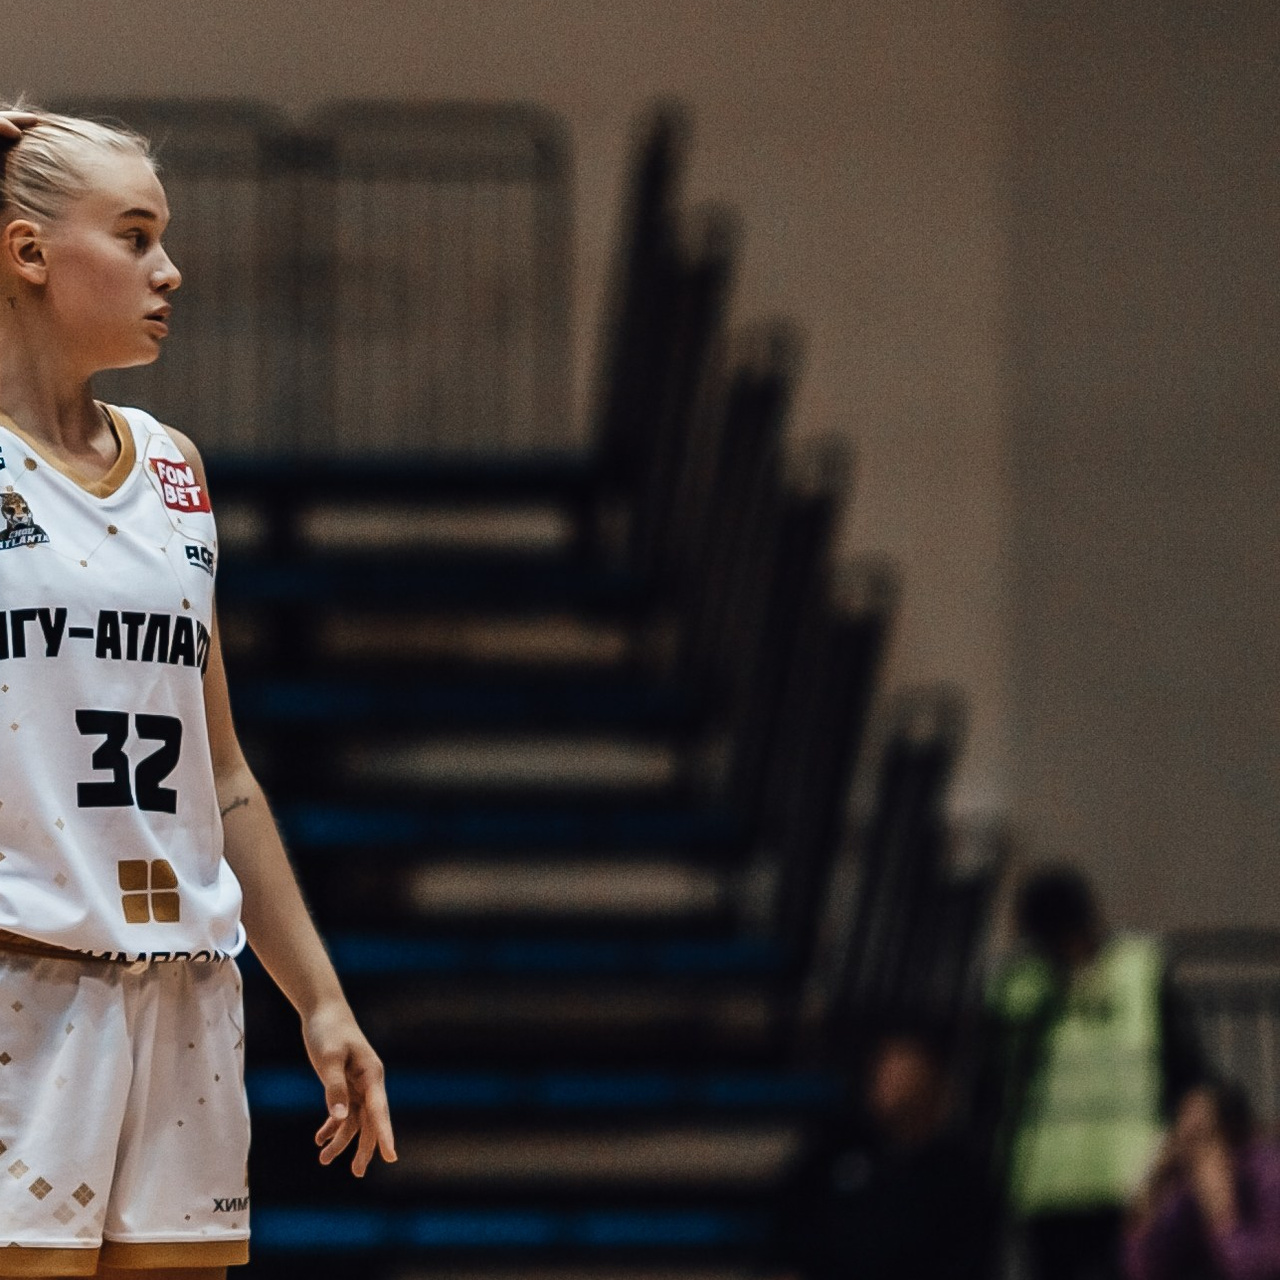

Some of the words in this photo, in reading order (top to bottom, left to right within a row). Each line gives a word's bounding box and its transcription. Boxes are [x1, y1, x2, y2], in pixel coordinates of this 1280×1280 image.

[156, 461, 195, 487] FON
[164, 482, 201, 507] BET
[75, 709, 182, 814] 32
